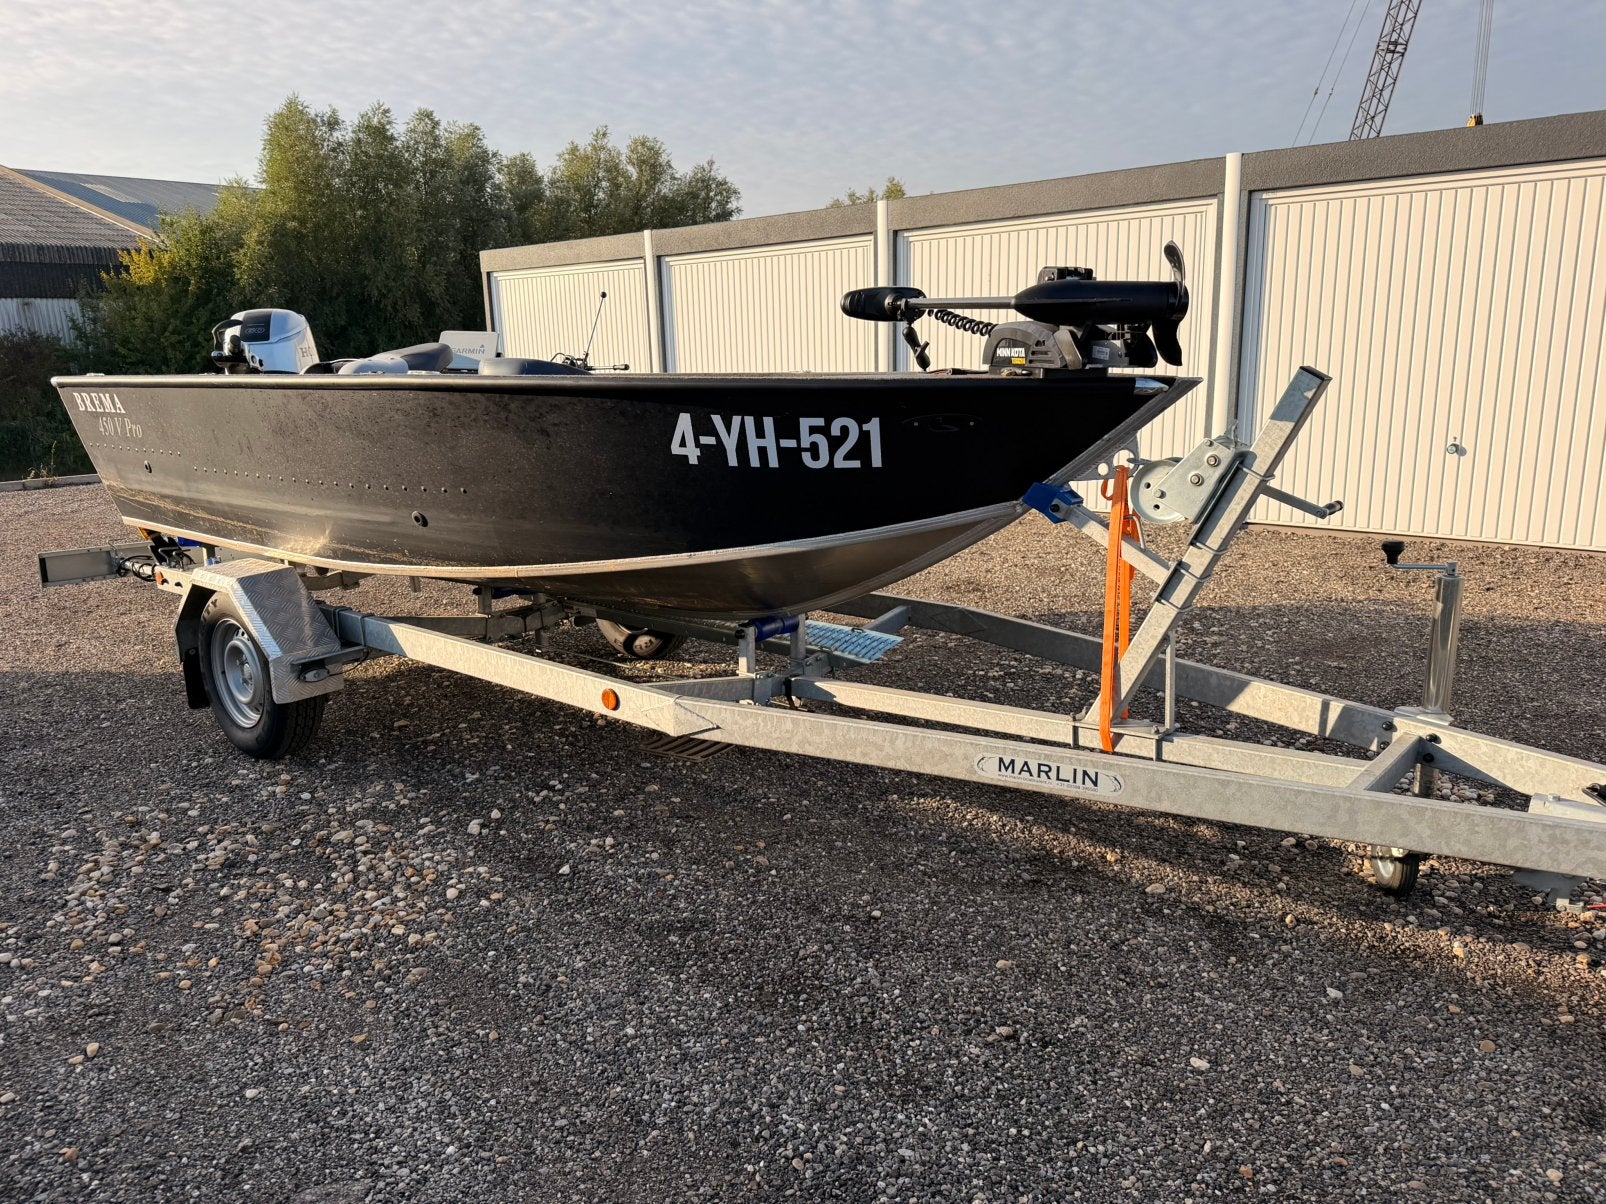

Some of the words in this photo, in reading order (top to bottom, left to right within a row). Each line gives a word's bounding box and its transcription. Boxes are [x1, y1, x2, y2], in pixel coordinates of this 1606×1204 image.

[1011, 347, 1026, 357] KOTA
[73, 392, 126, 413] BREMA
[99, 416, 115, 436] 450
[115, 417, 122, 436] V
[124, 417, 143, 438] Pro
[670, 412, 883, 469] 4-YH-521
[998, 757, 1098, 787] MARLIN
